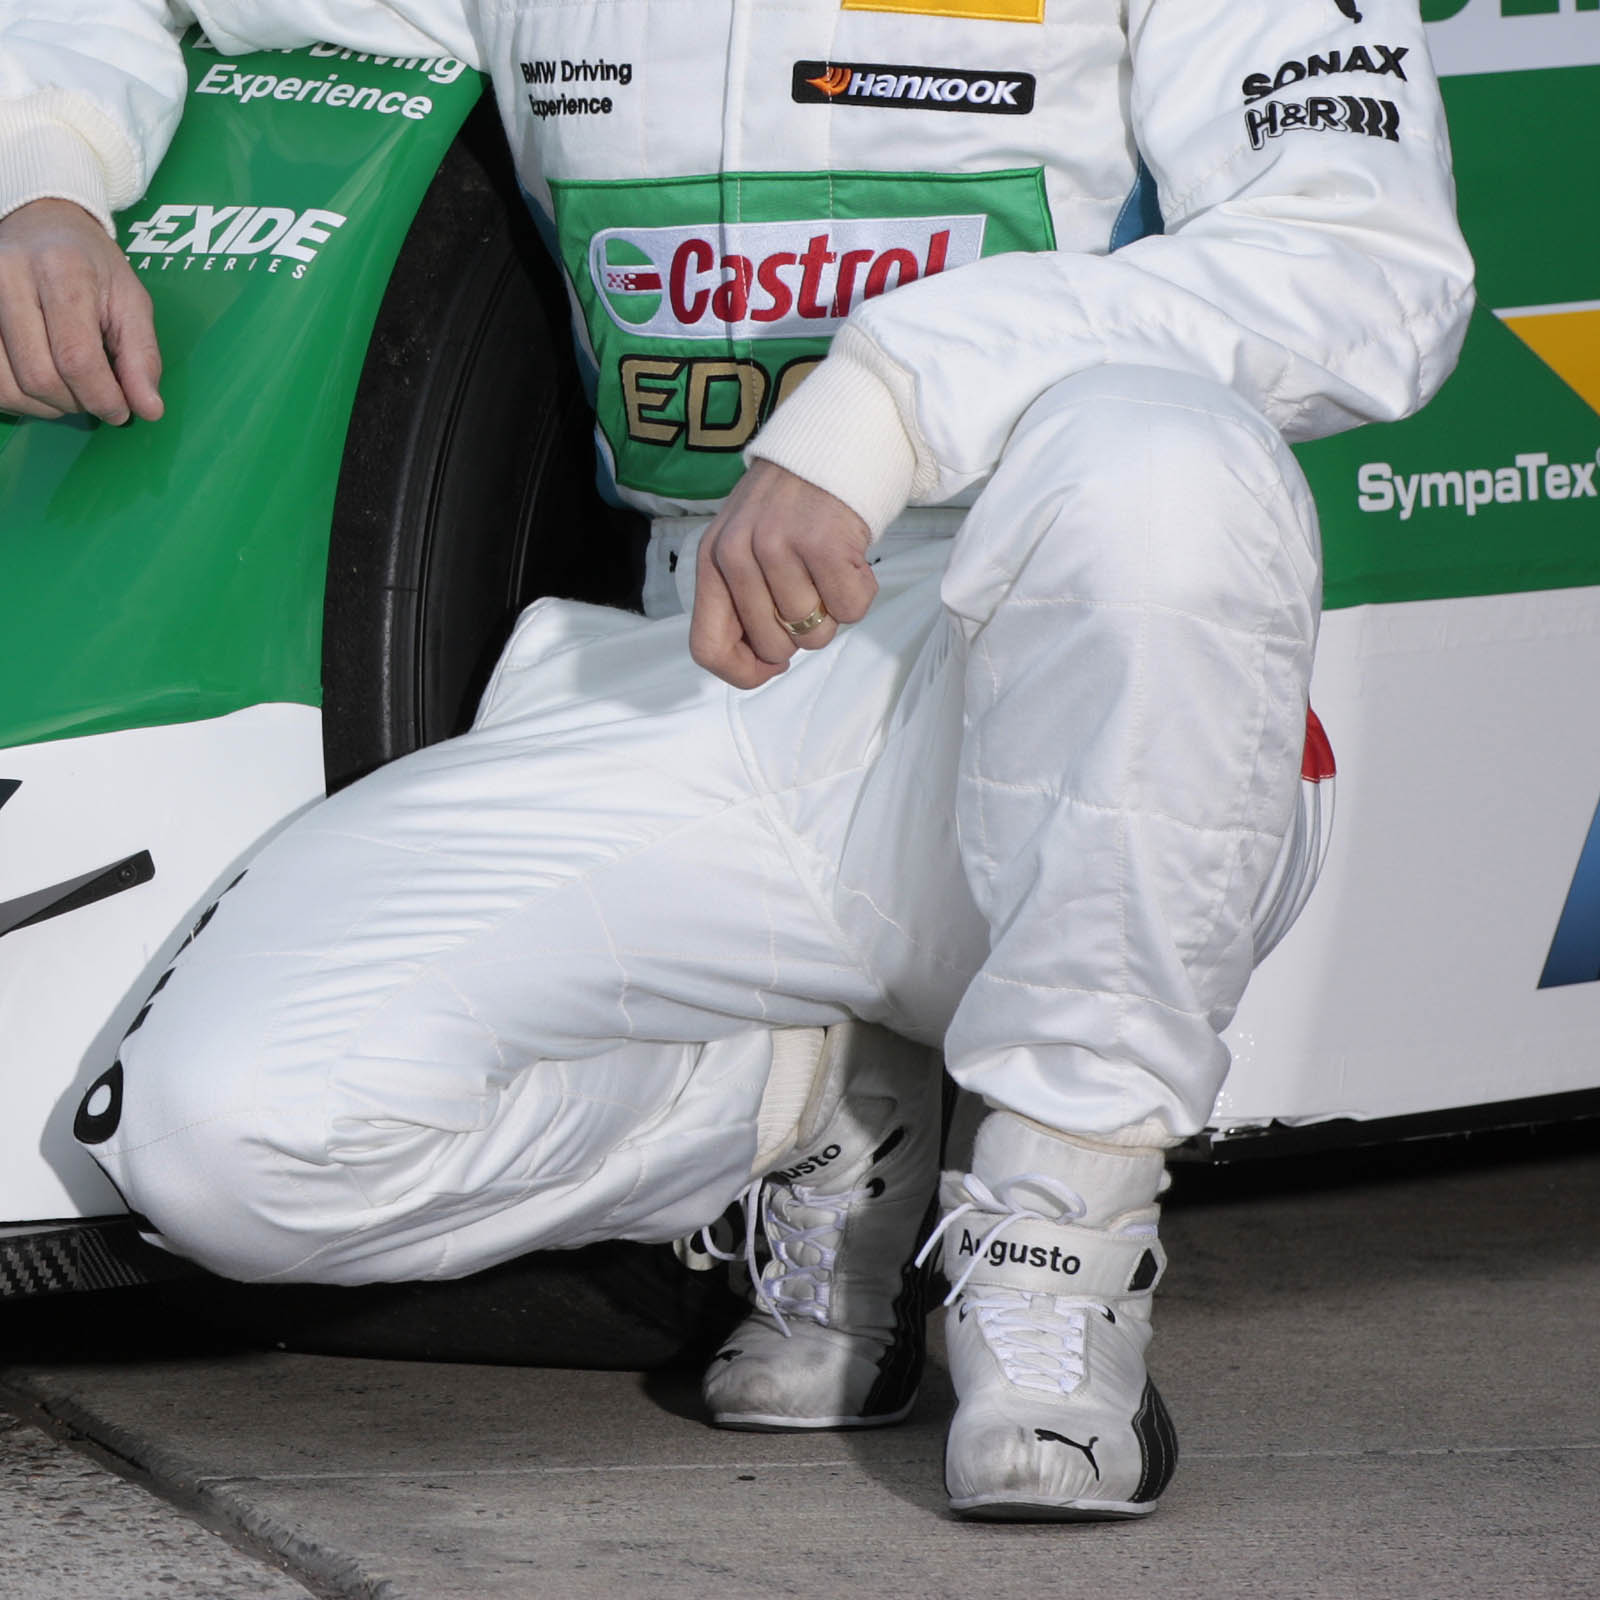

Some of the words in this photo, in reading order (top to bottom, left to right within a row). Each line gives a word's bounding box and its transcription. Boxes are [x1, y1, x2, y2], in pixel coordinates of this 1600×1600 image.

[195, 64, 432, 120] Experience
[520, 60, 556, 84] BMW
[561, 58, 632, 85] Driving
[1242, 45, 1409, 105] SONAX
[126, 205, 347, 262] EXIDE
[127, 256, 308, 280] ATTERIES
[669, 229, 950, 325] Castrol
[619, 355, 824, 451] ED
[1358, 452, 1597, 521] SympaTex
[780, 1144, 841, 1179] usto
